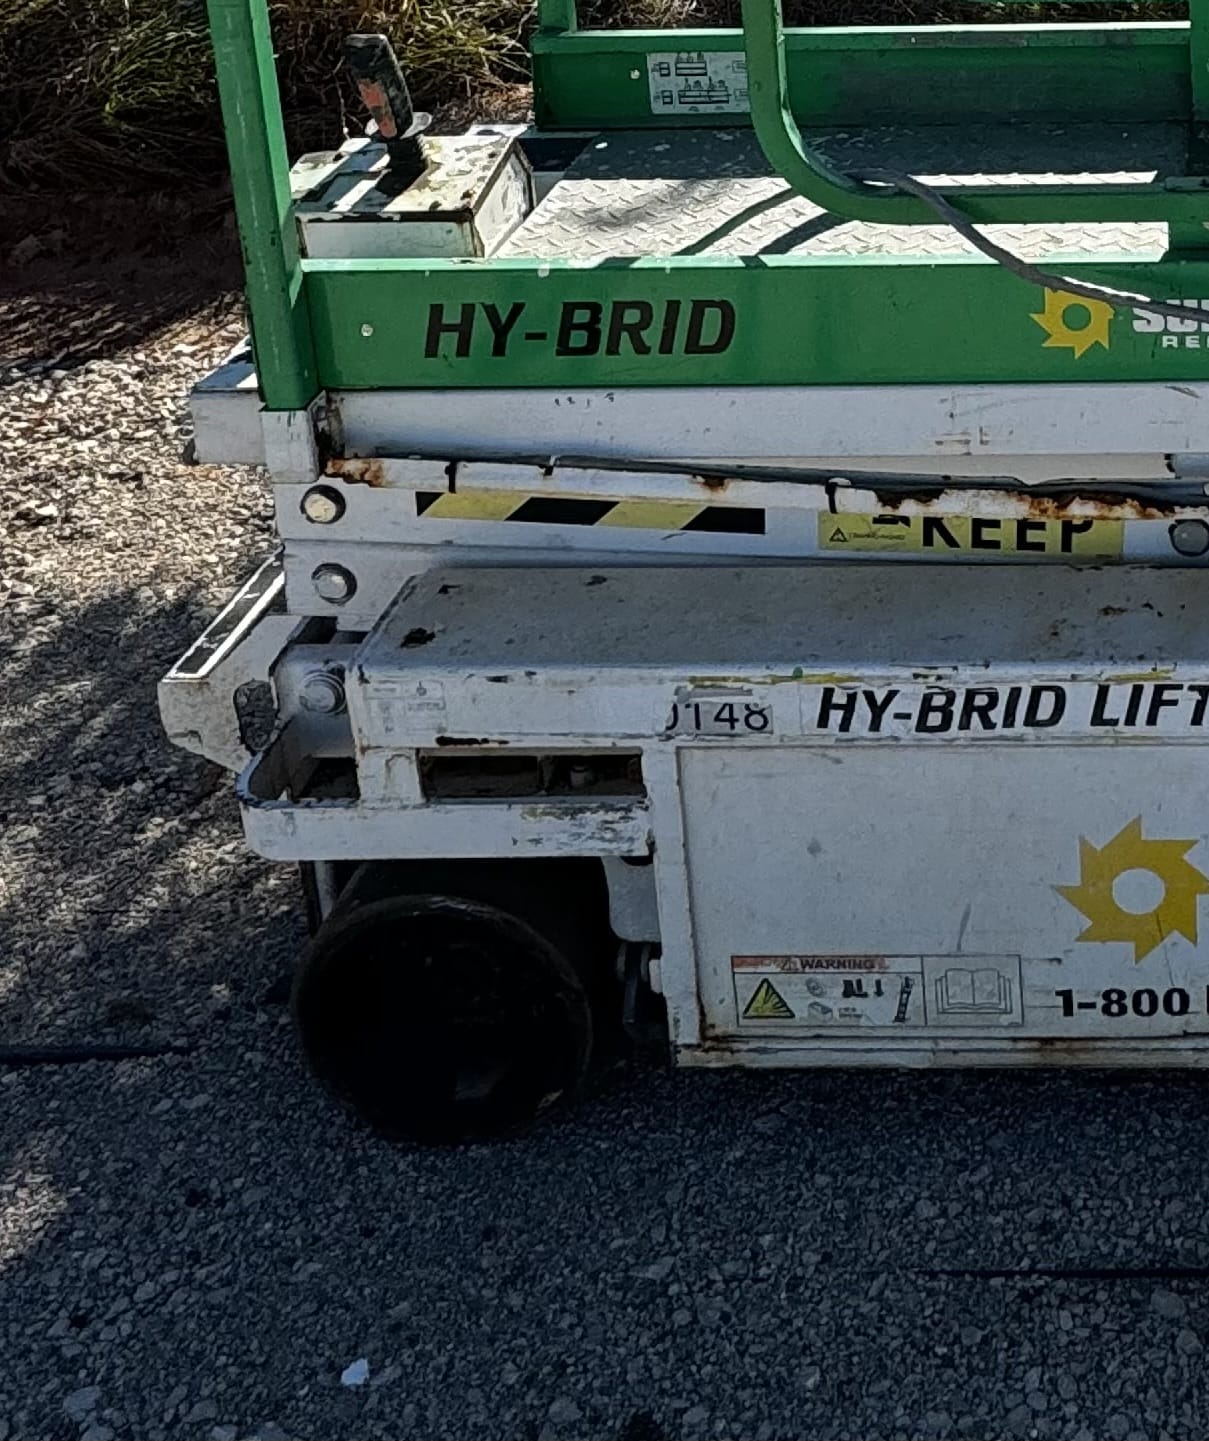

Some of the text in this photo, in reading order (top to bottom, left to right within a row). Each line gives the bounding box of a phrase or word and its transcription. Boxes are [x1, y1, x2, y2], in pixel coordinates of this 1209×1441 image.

[424, 299, 736, 358] HY-BRID
[922, 517, 1094, 553] KEEP
[816, 686, 1067, 732] HY-BRID
[1055, 988, 1191, 1017] 1-800
